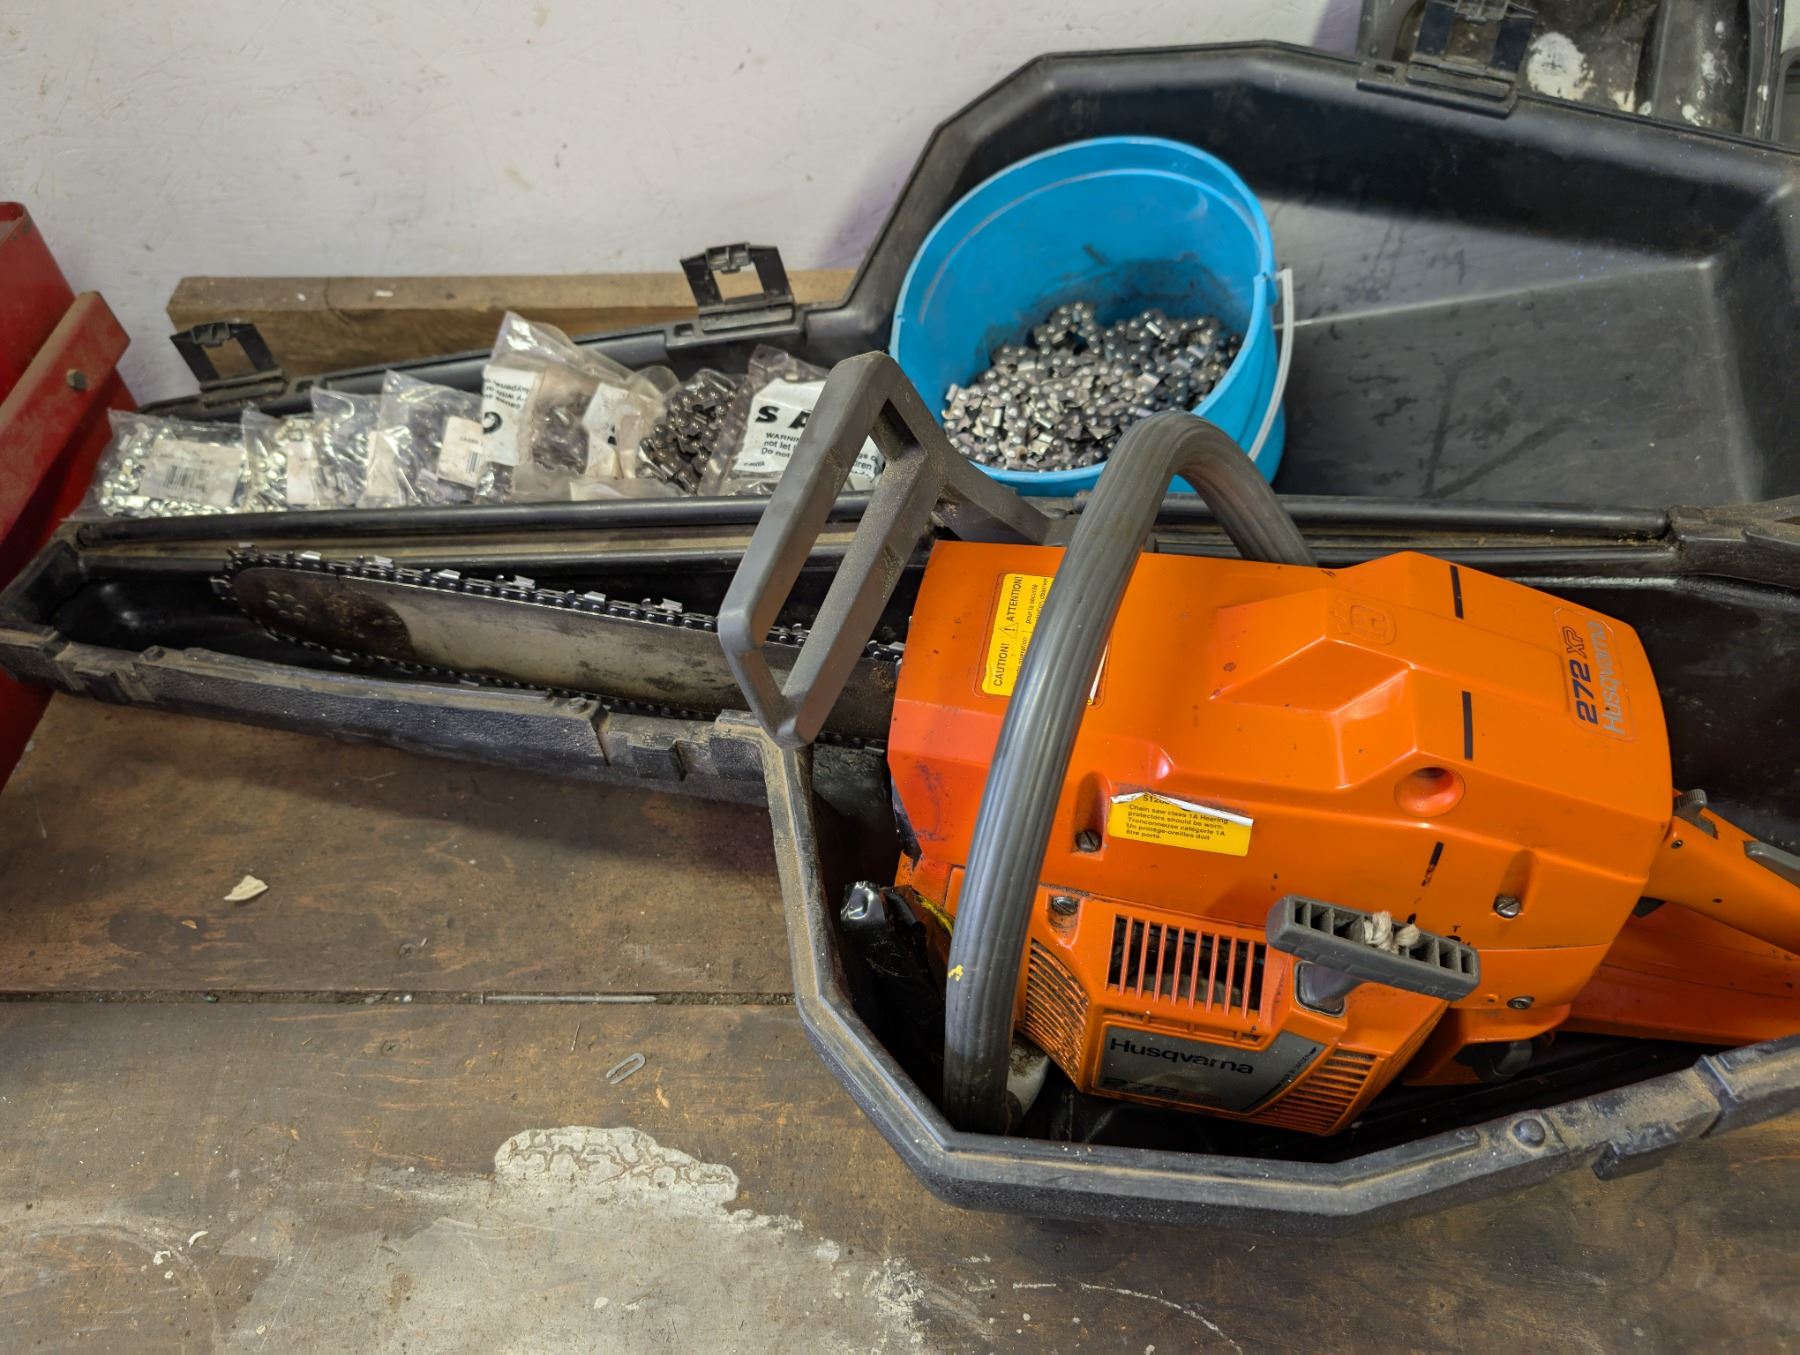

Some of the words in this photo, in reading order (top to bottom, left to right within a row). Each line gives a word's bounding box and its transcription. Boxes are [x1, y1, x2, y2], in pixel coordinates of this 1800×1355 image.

[993, 642, 1011, 687] CAUTION!
[1006, 576, 1024, 623] ATTENTION!
[1562, 626, 1587, 659] XP
[1569, 658, 1599, 725] 272
[1587, 620, 1626, 736] Husqvarna
[1128, 811, 1165, 821] protectors
[1167, 817, 1191, 825] should
[1129, 804, 1150, 812] Chain
[1167, 810, 1187, 818] class
[1200, 814, 1229, 825] Hearing
[1109, 1037, 1255, 1075] Husqvarna
